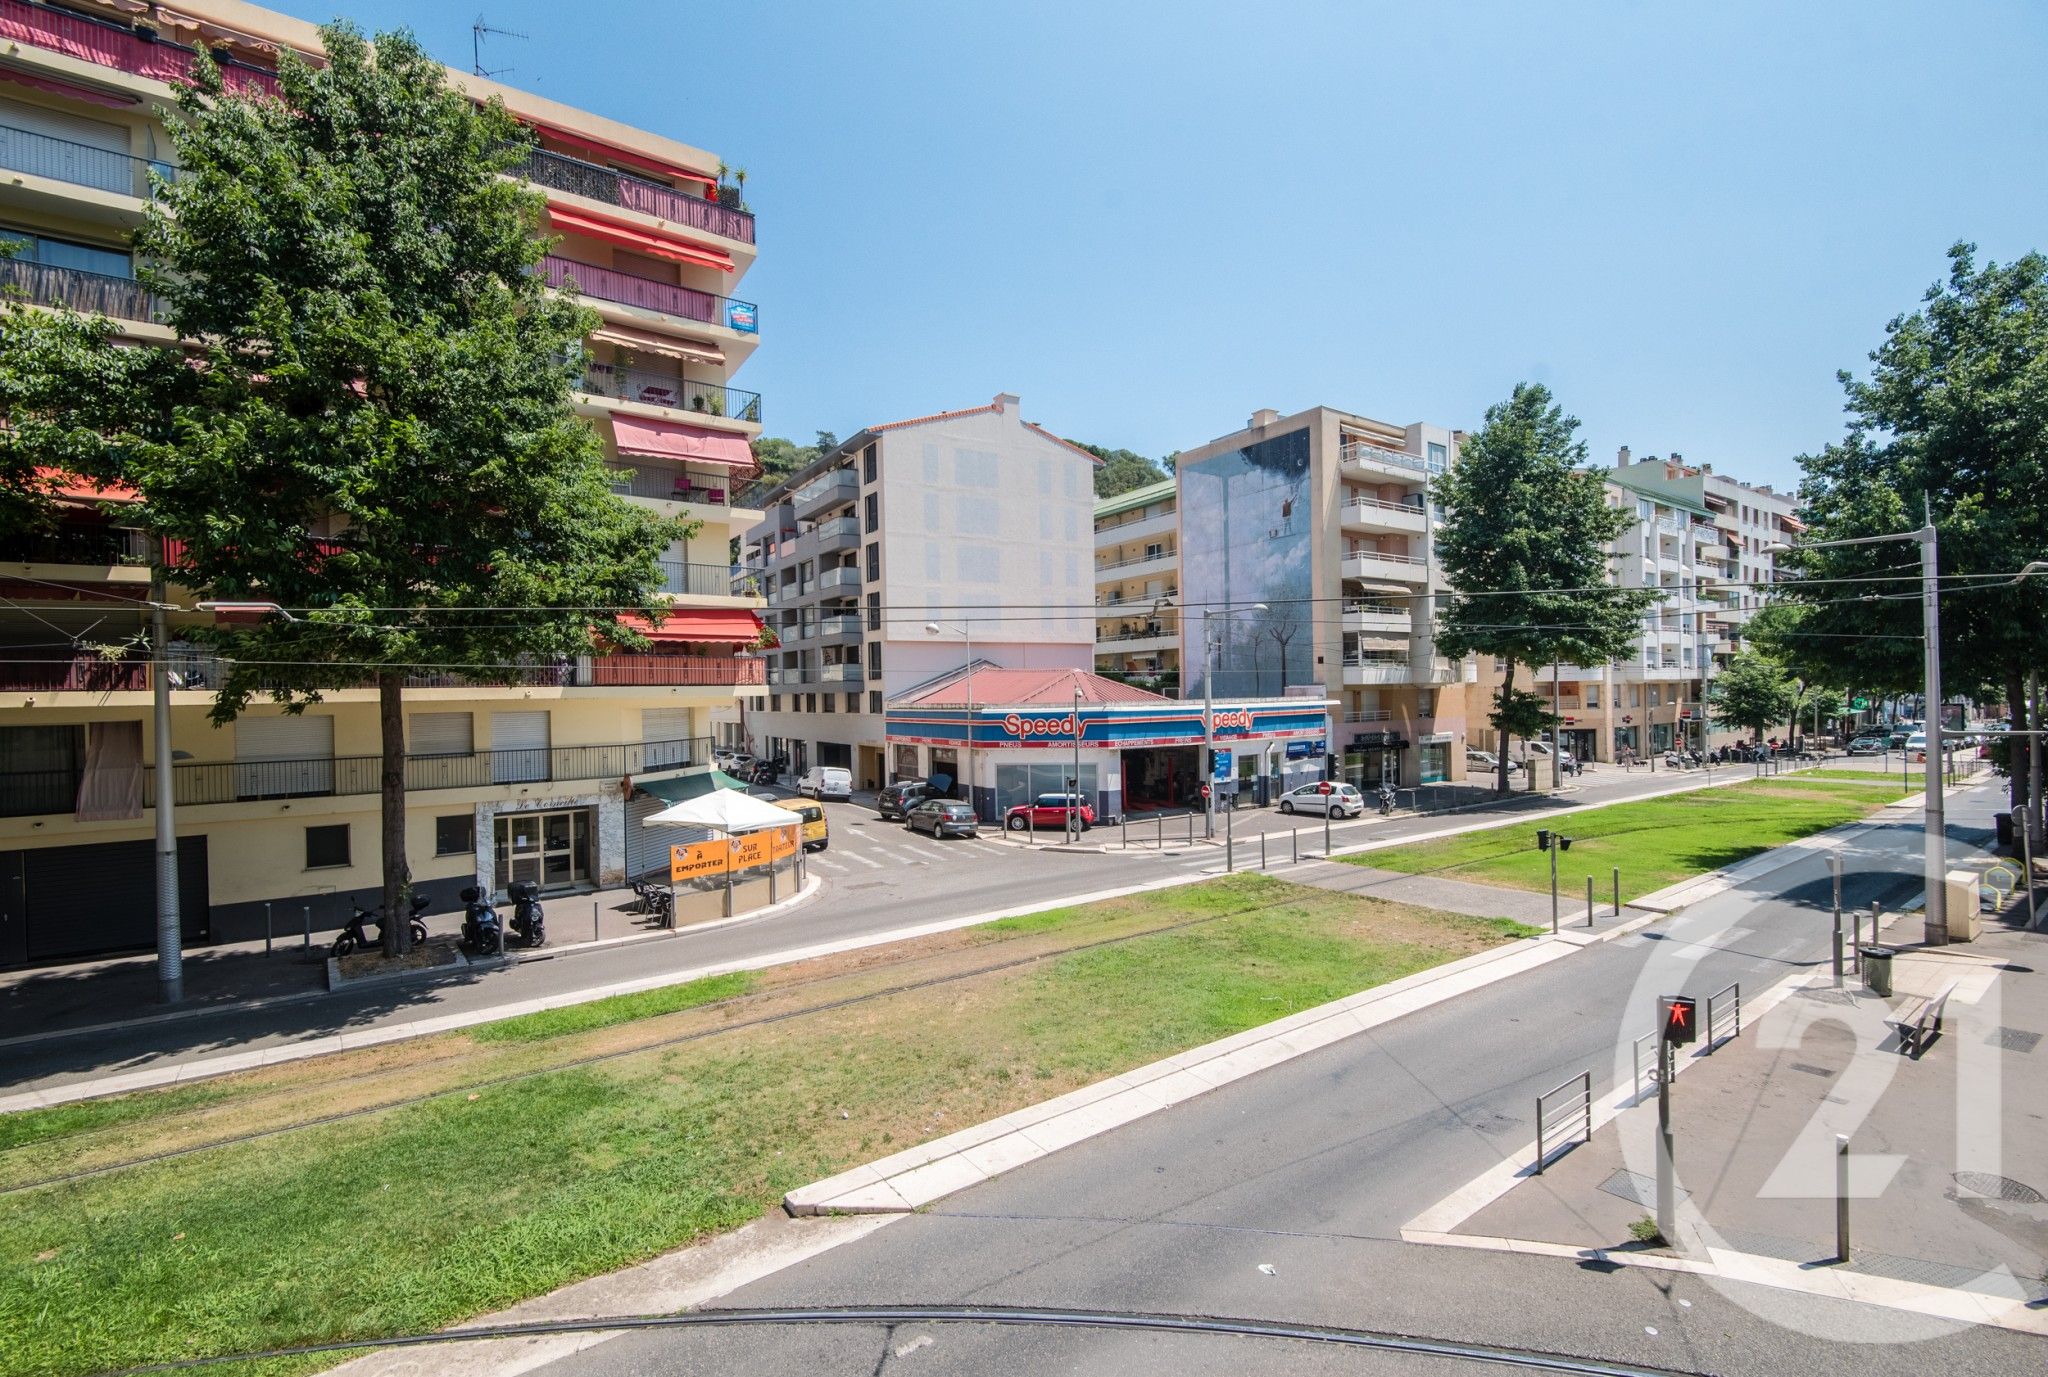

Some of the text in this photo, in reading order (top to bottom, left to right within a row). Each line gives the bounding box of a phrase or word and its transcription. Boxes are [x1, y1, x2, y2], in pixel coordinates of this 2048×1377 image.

[1004, 713, 1087, 739] Speedy
[1202, 704, 1254, 733] peedy
[742, 843, 758, 853] SUR
[738, 851, 762, 864] PLACE
[675, 858, 723, 873] EMPORTER
